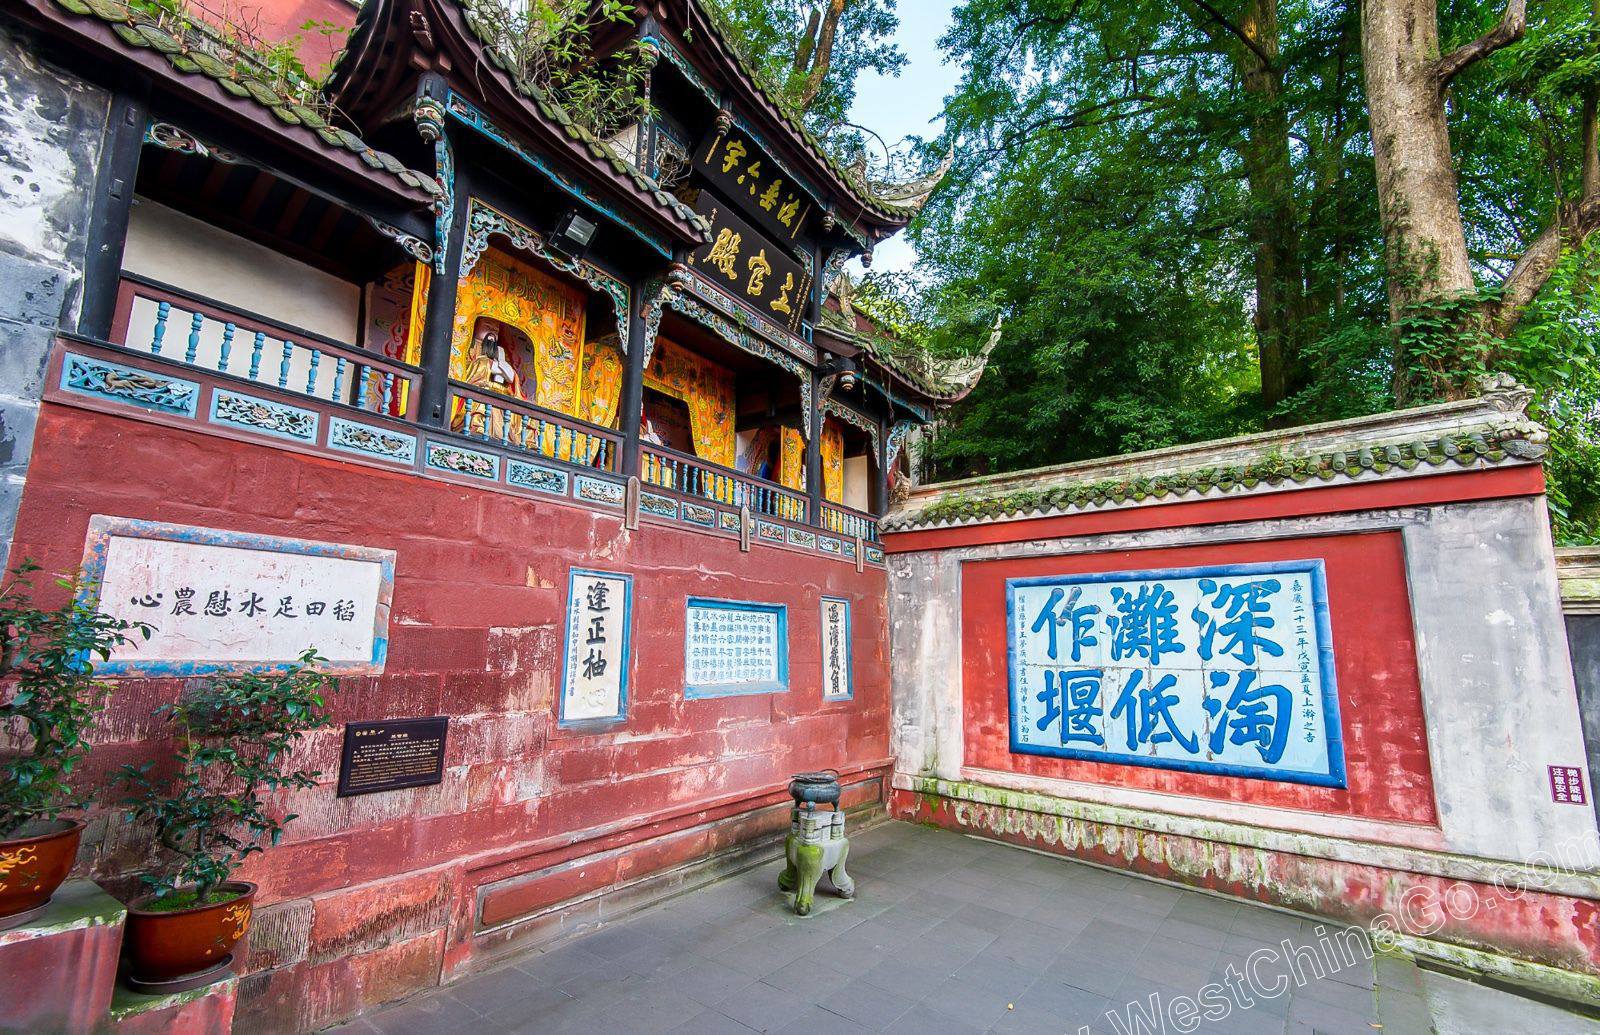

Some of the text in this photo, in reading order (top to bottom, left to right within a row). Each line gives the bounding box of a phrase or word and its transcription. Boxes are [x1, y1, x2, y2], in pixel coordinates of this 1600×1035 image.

[130, 587, 356, 622] 稻田足水慰農心
[1031, 586, 1105, 746] 作堰
[1106, 584, 1200, 756] 灘低
[1191, 578, 1293, 765] 深淘
[1552, 768, 1568, 801] 注意安全
